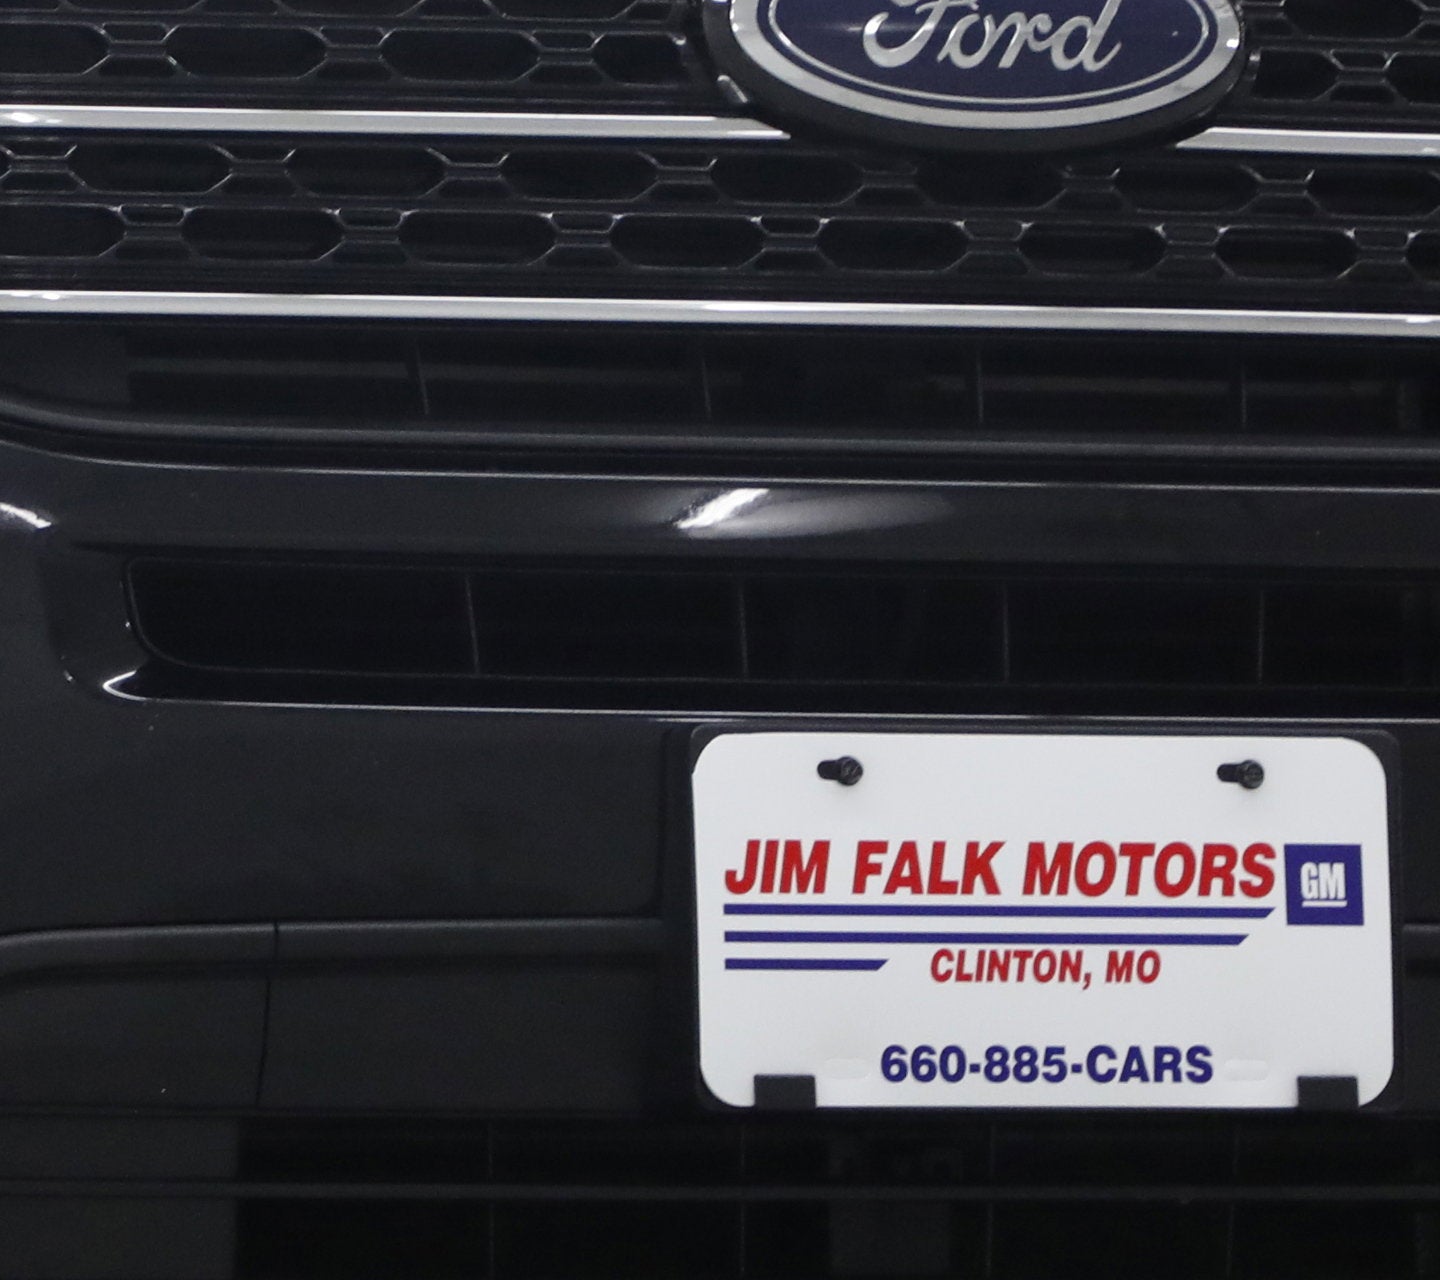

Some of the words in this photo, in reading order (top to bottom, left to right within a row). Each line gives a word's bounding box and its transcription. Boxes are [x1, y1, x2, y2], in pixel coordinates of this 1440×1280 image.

[724, 839, 831, 896] JIM
[852, 840, 1006, 896] FALK
[1022, 841, 1277, 899] MOTORS
[1300, 862, 1347, 901] GM
[930, 949, 1092, 991] CLINTON,
[1104, 949, 1161, 984] MO
[880, 1044, 1214, 1084] 660-885-CARS
